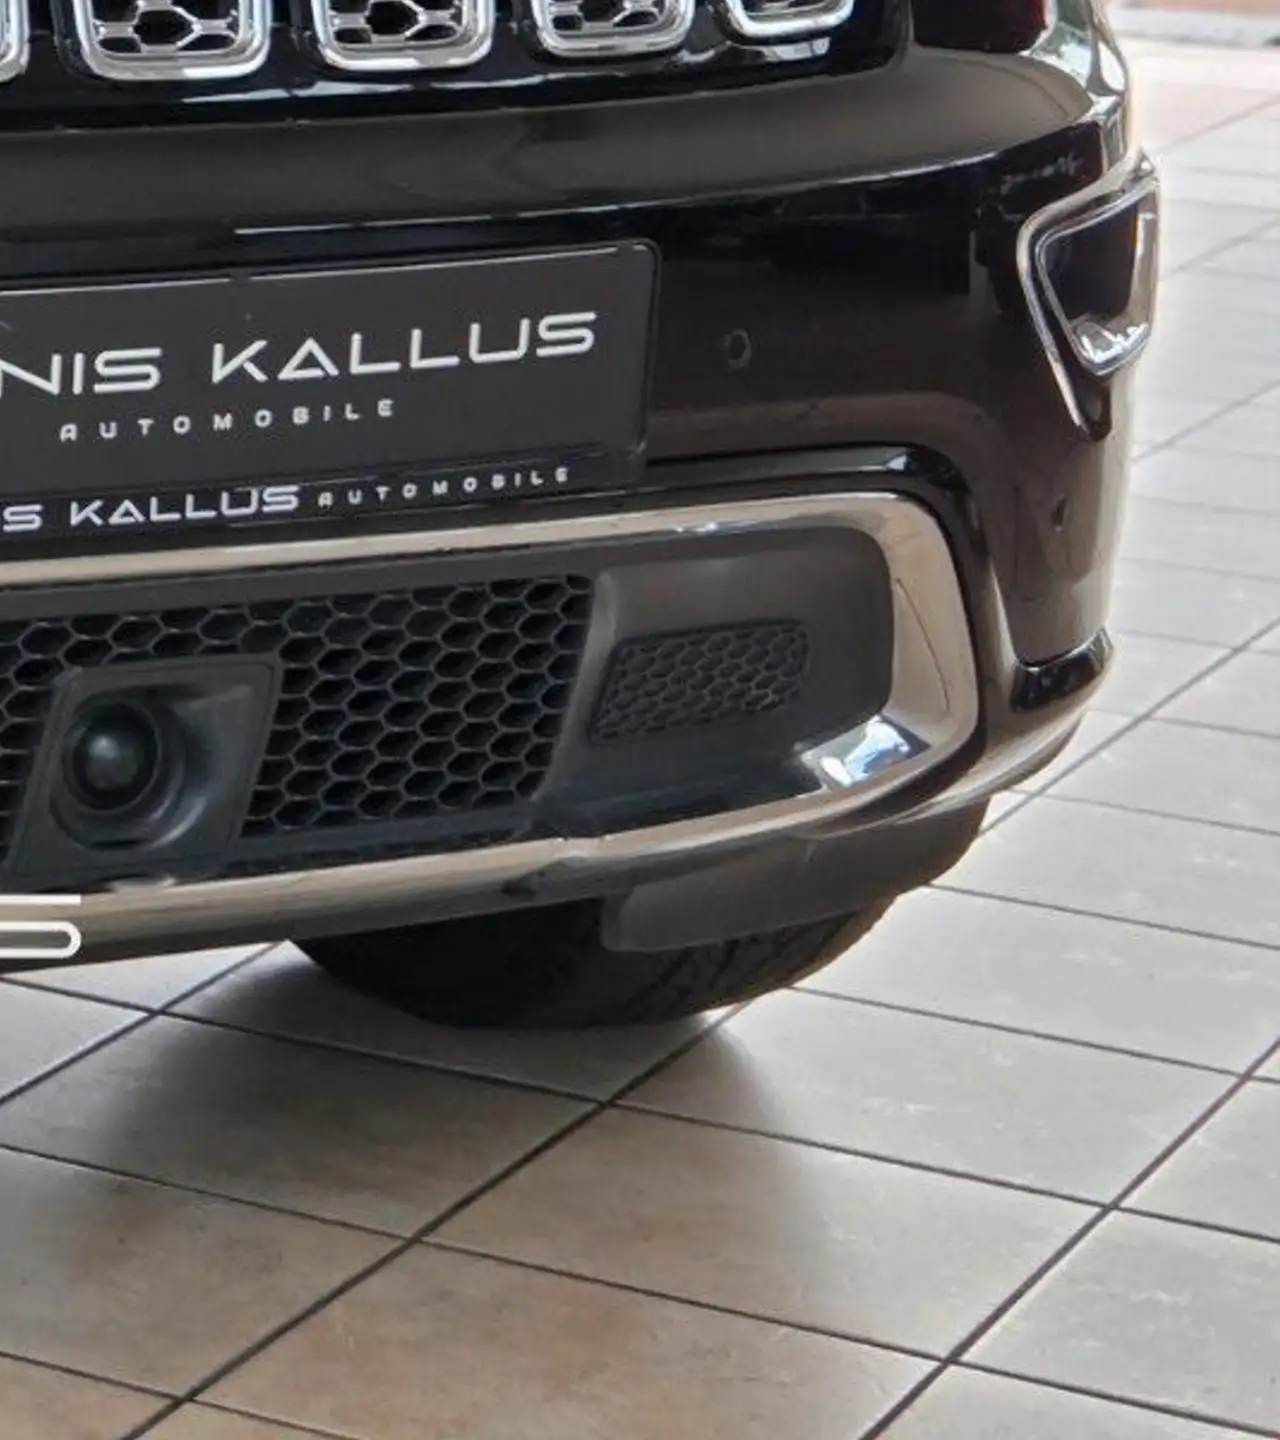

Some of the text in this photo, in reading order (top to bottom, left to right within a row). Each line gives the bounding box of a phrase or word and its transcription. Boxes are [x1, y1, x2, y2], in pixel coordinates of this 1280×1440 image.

[211, 312, 597, 384] KALLUS
[59, 399, 395, 442] AUTOMOBILE
[69, 485, 300, 527] KALLUS
[317, 466, 570, 507] AUTOMOBILE
